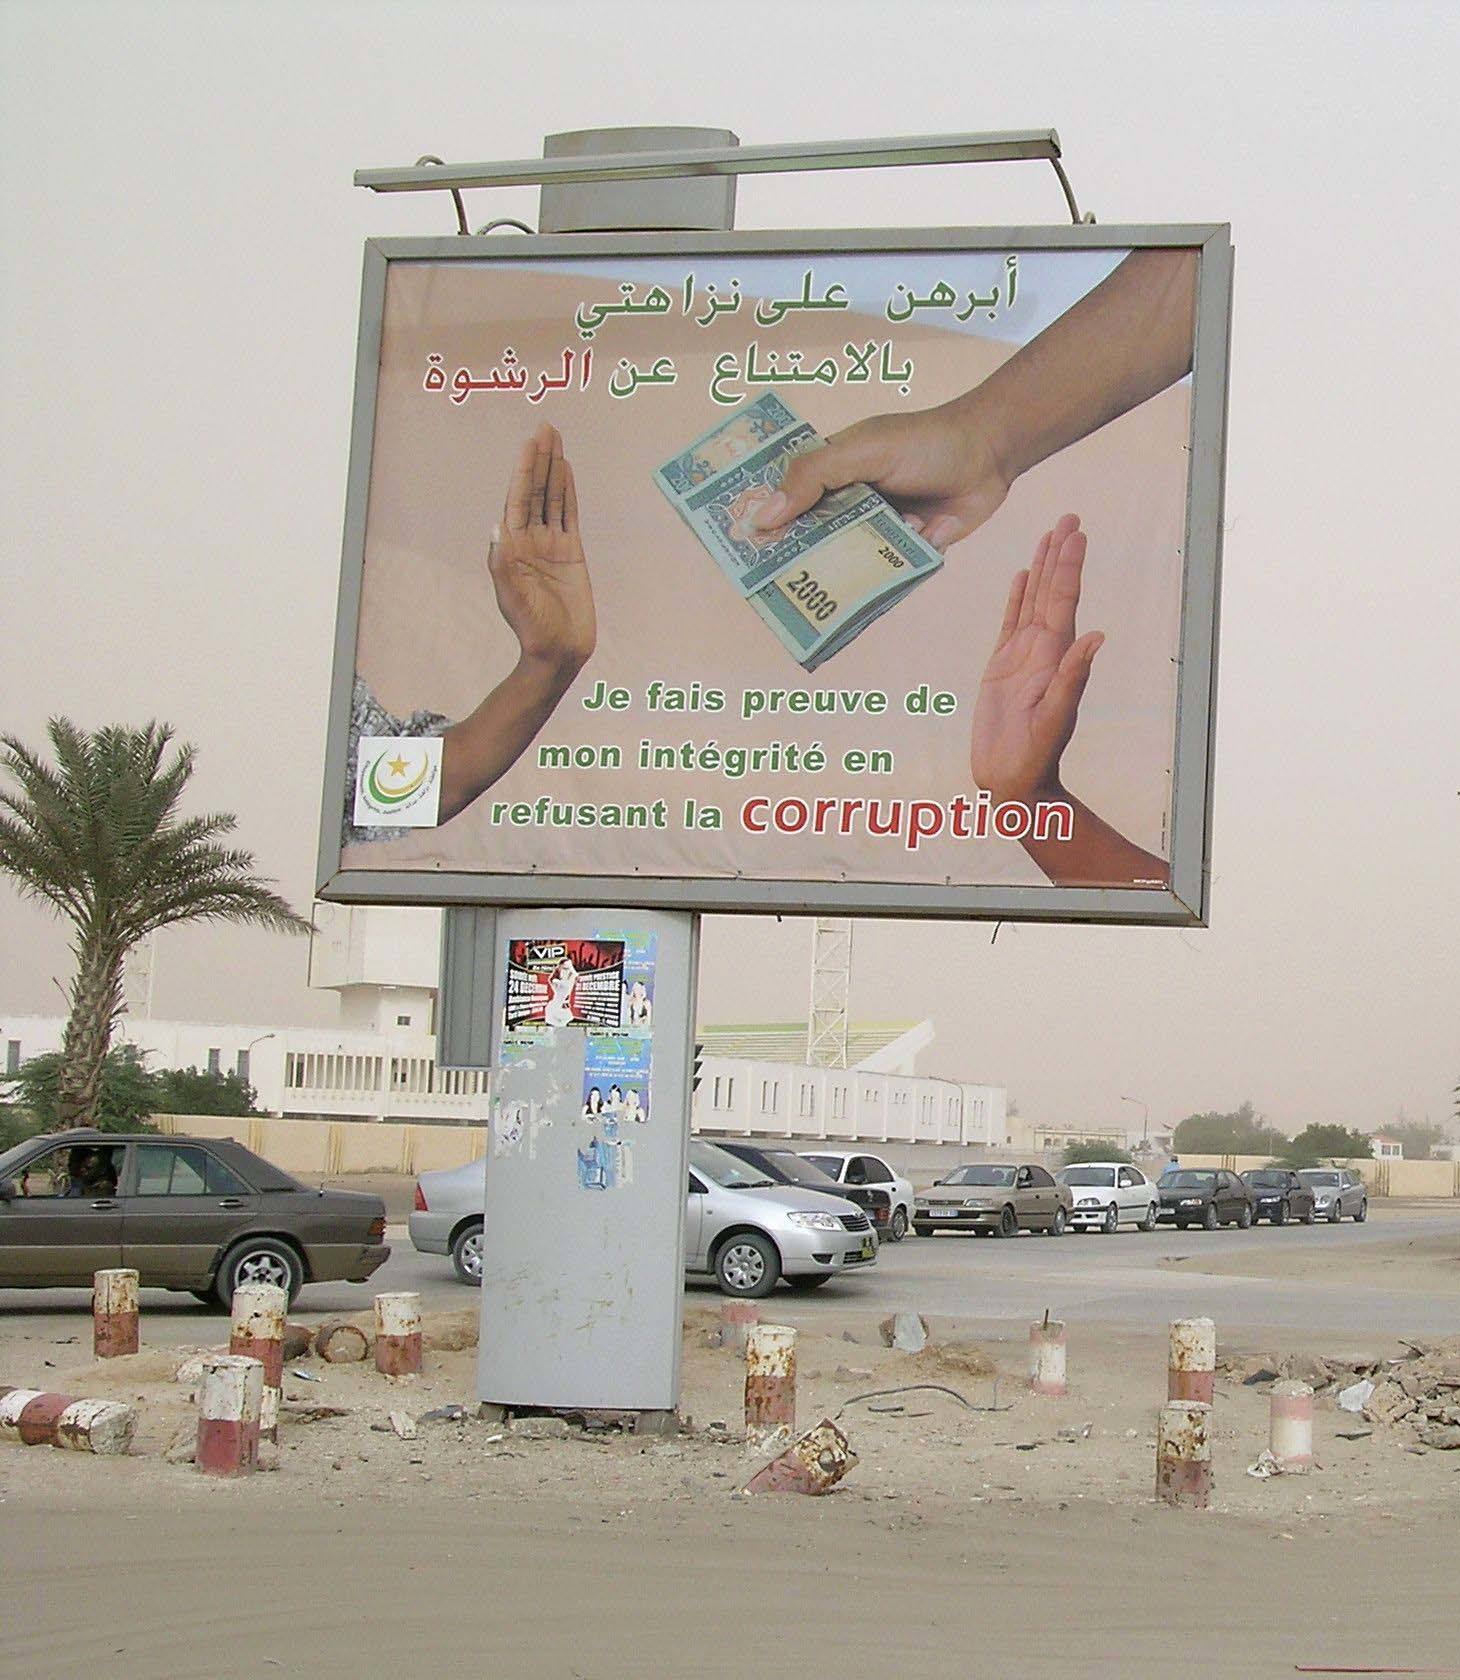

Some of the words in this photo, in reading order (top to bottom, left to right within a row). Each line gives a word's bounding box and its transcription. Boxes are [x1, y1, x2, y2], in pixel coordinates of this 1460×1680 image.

[575, 273, 742, 340] نزاهتي
[754, 269, 850, 327] على
[886, 254, 1019, 322] أبرهن
[424, 347, 594, 404] الرشوة
[608, 356, 678, 399] عن
[710, 341, 914, 404] بالامتناع
[877, 546, 905, 569] 2000
[787, 570, 839, 622] 2000
[582, 681, 632, 711] Je
[646, 682, 726, 712] fais
[742, 688, 888, 719] preuve
[904, 684, 958, 715] de
[537, 744, 622, 769] mon
[638, 740, 826, 778] intégrité
[842, 750, 894, 774] en
[491, 796, 667, 830] refusant
[684, 800, 723, 830] la
[741, 791, 1074, 851] corruption
[533, 946, 564, 959] VIP
[508, 980, 519, 993] 24
